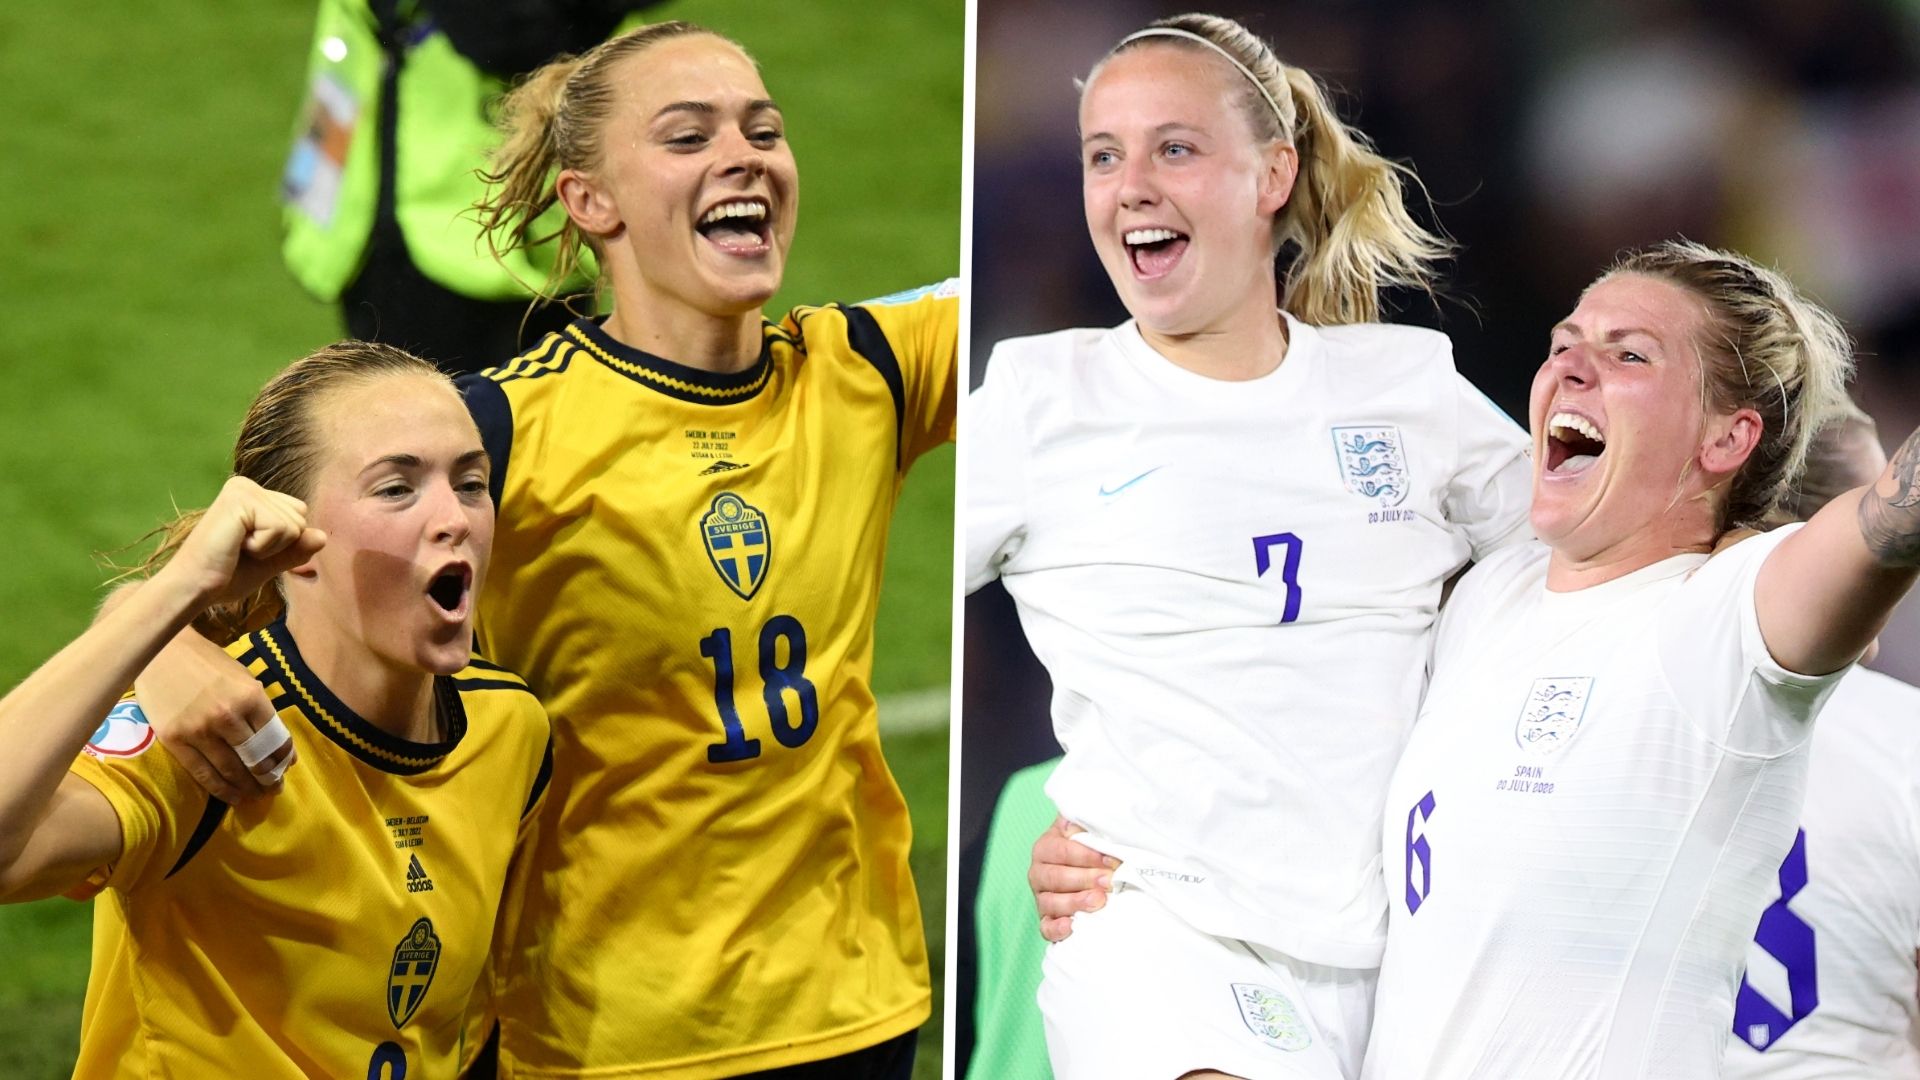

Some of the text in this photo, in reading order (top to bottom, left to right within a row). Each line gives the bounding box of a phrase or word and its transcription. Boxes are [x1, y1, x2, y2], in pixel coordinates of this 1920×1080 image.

[685, 430, 706, 439] SWEDEN
[711, 431, 736, 440] BELGIUM
[701, 442, 714, 450] JULY
[1380, 510, 1402, 523] JULY
[713, 521, 756, 534] SVERIGE
[1252, 532, 1304, 624] 7
[700, 614, 819, 763] 18
[1514, 765, 1544, 778] SPAIN
[1496, 779, 1555, 794] 20 JULY 2022
[1405, 789, 1436, 916] 6
[407, 879, 434, 893] adidas
[402, 951, 430, 960] SVERIGE
